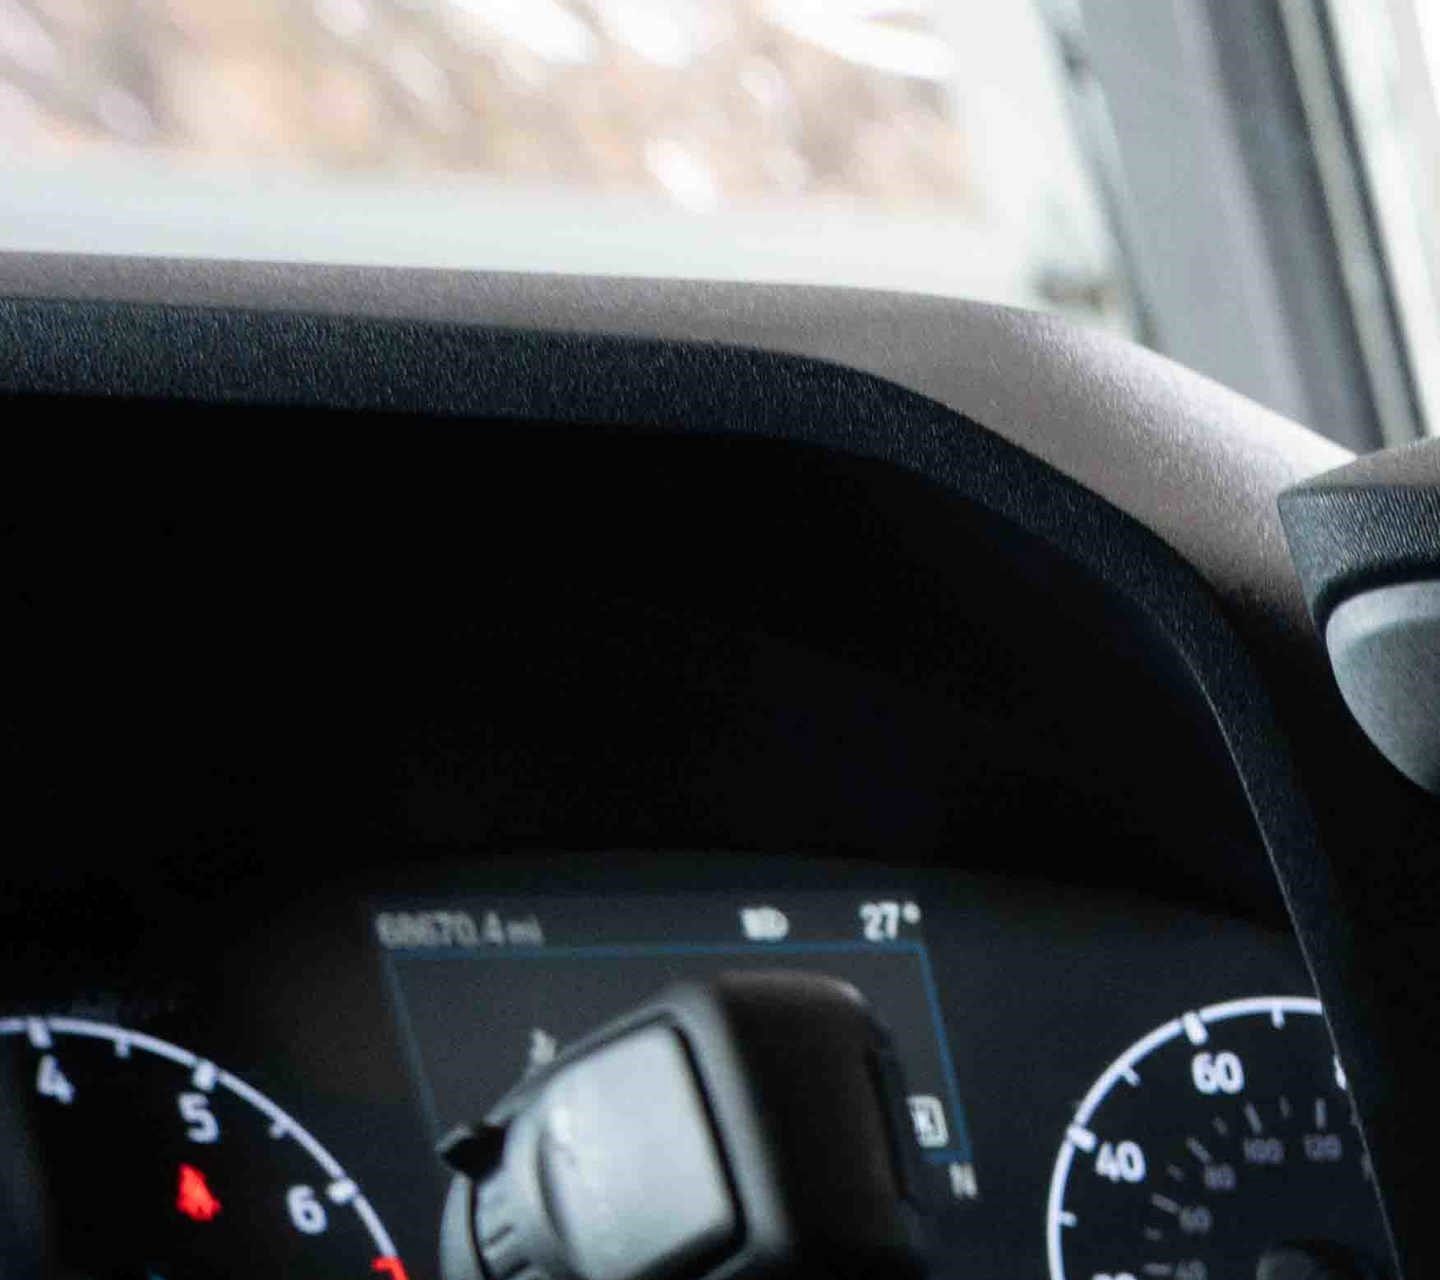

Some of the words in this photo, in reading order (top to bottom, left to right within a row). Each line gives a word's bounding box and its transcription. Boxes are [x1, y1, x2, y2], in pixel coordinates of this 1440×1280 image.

[39, 1057, 73, 1101] 4
[1193, 1053, 1243, 1092] 60
[181, 1095, 218, 1141] 5
[1093, 1139, 1145, 1182] 40
[289, 1187, 326, 1232] 6
